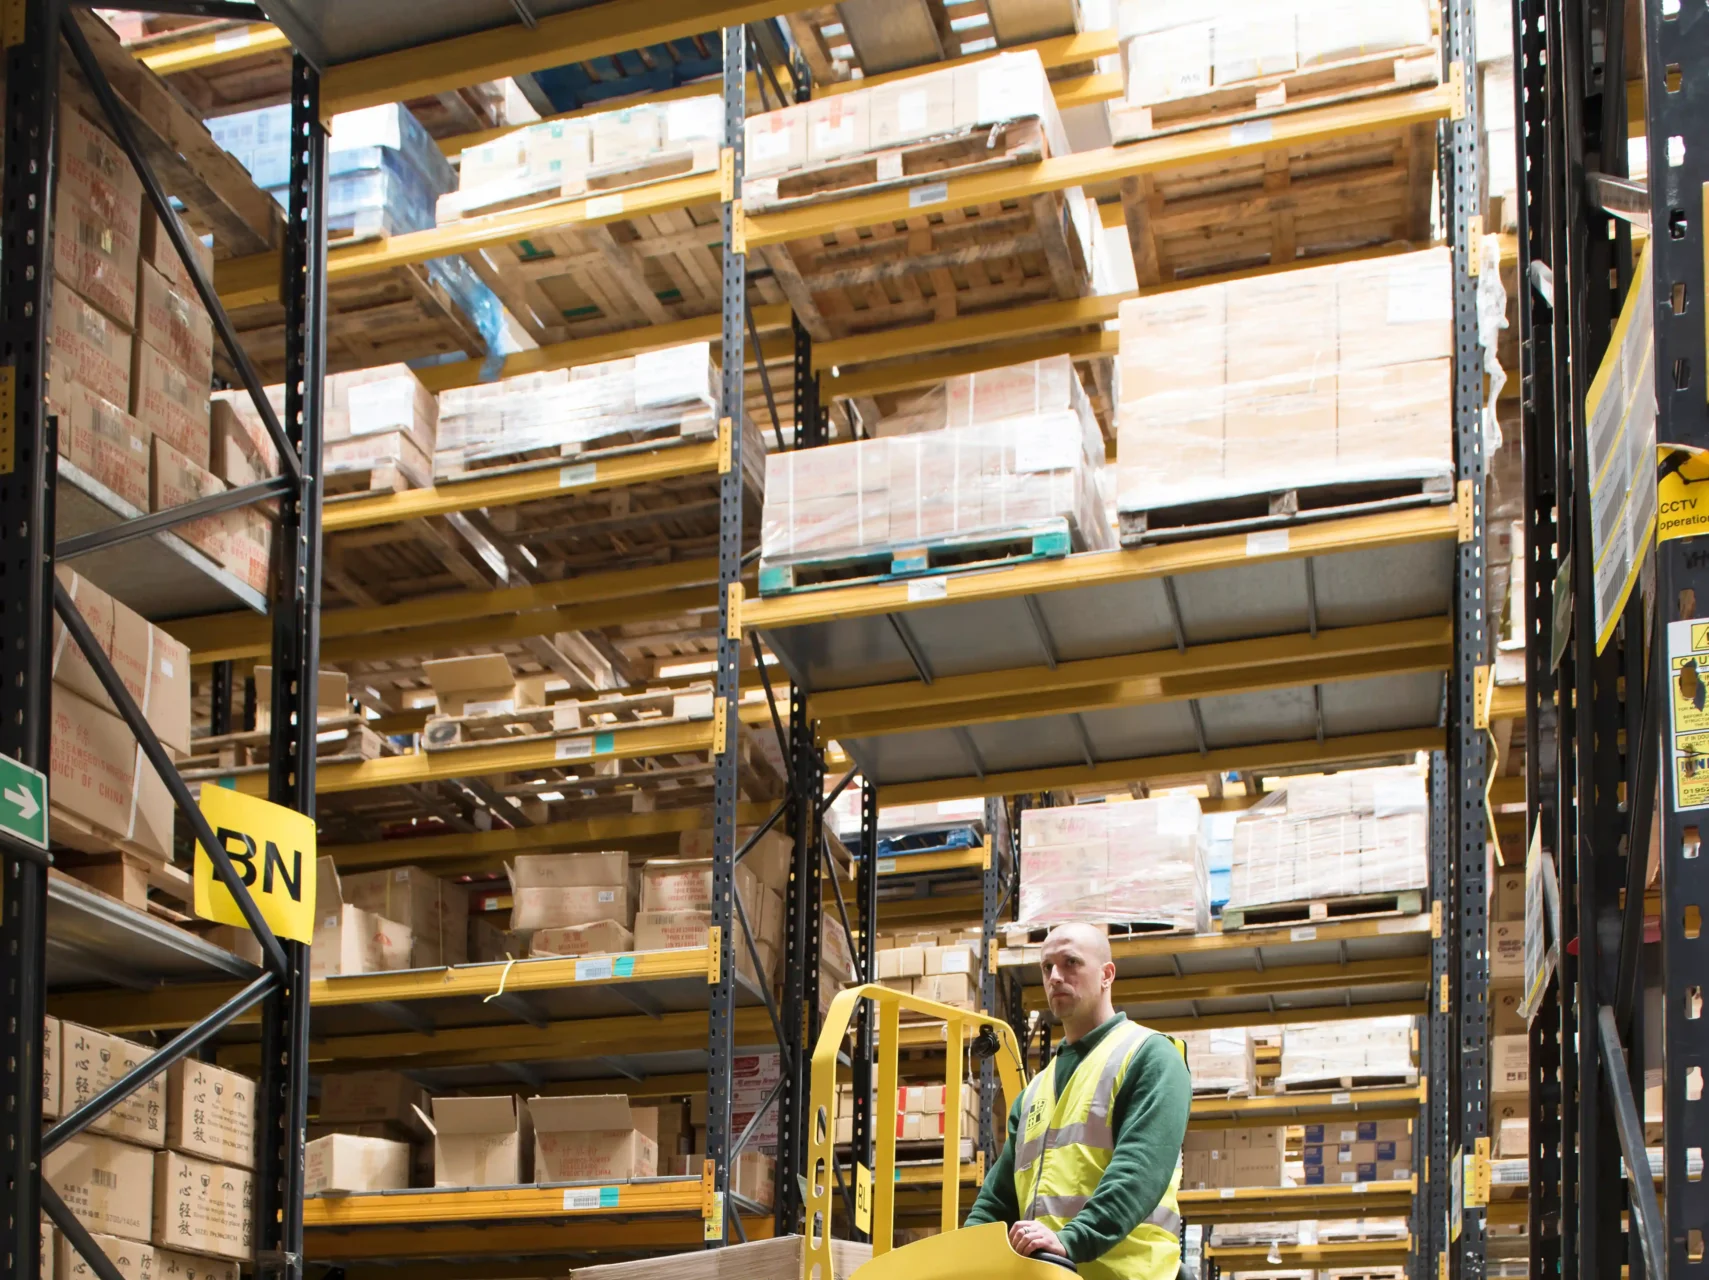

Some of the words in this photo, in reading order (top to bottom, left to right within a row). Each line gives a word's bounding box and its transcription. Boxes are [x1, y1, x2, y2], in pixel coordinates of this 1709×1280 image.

[1659, 514, 1709, 531] operatio
[1660, 498, 1698, 514] CCTV
[81, 773, 93, 789] OF
[98, 782, 124, 806] CHINA
[212, 826, 302, 903] BN
[192, 1072, 208, 1144] 小心轻放
[178, 1165, 193, 1237] 小心轻放
